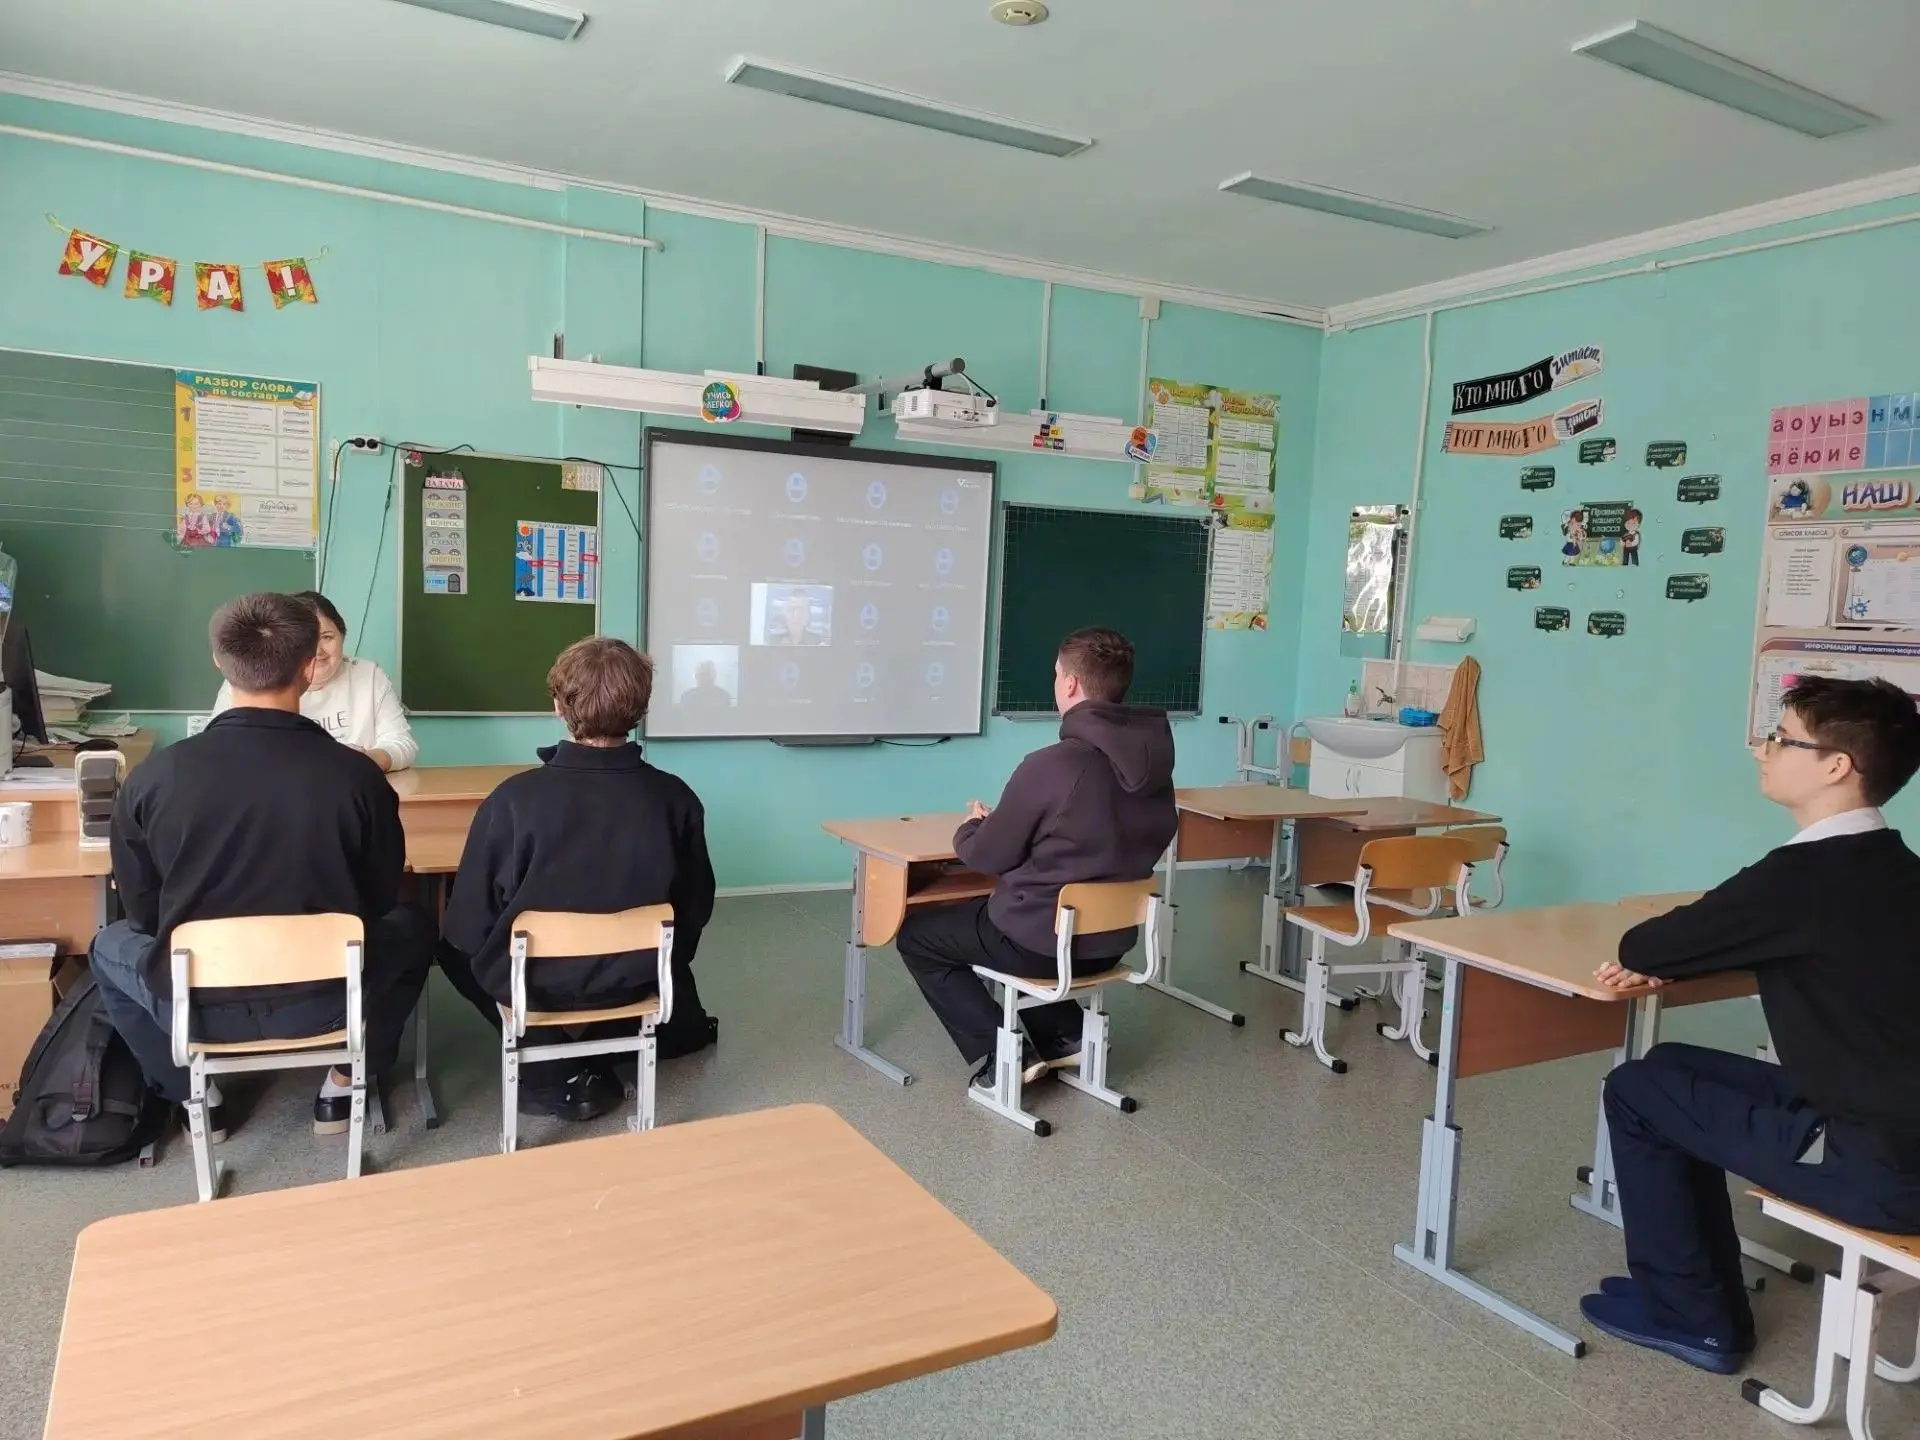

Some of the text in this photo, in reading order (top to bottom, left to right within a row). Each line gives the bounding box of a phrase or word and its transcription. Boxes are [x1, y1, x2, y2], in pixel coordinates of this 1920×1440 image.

[195, 375, 294, 393] РАЗБОР СЛОВА
[1485, 369, 1545, 403] МНОГО
[231, 390, 279, 401] составу
[1773, 419, 1784, 433] а
[1790, 418, 1803, 431] о
[1810, 415, 1822, 433] у
[1829, 413, 1846, 427] ы
[1852, 411, 1864, 425] э
[1453, 428, 1484, 448] ТОТ
[1486, 424, 1547, 449] МНОГО
[1769, 446, 1861, 467] я ё ю и е
[1842, 481, 1904, 506] НАШ
[1590, 508, 1625, 517] Правила
[1804, 642, 1857, 651] ИНФОРМАЦИЯ
